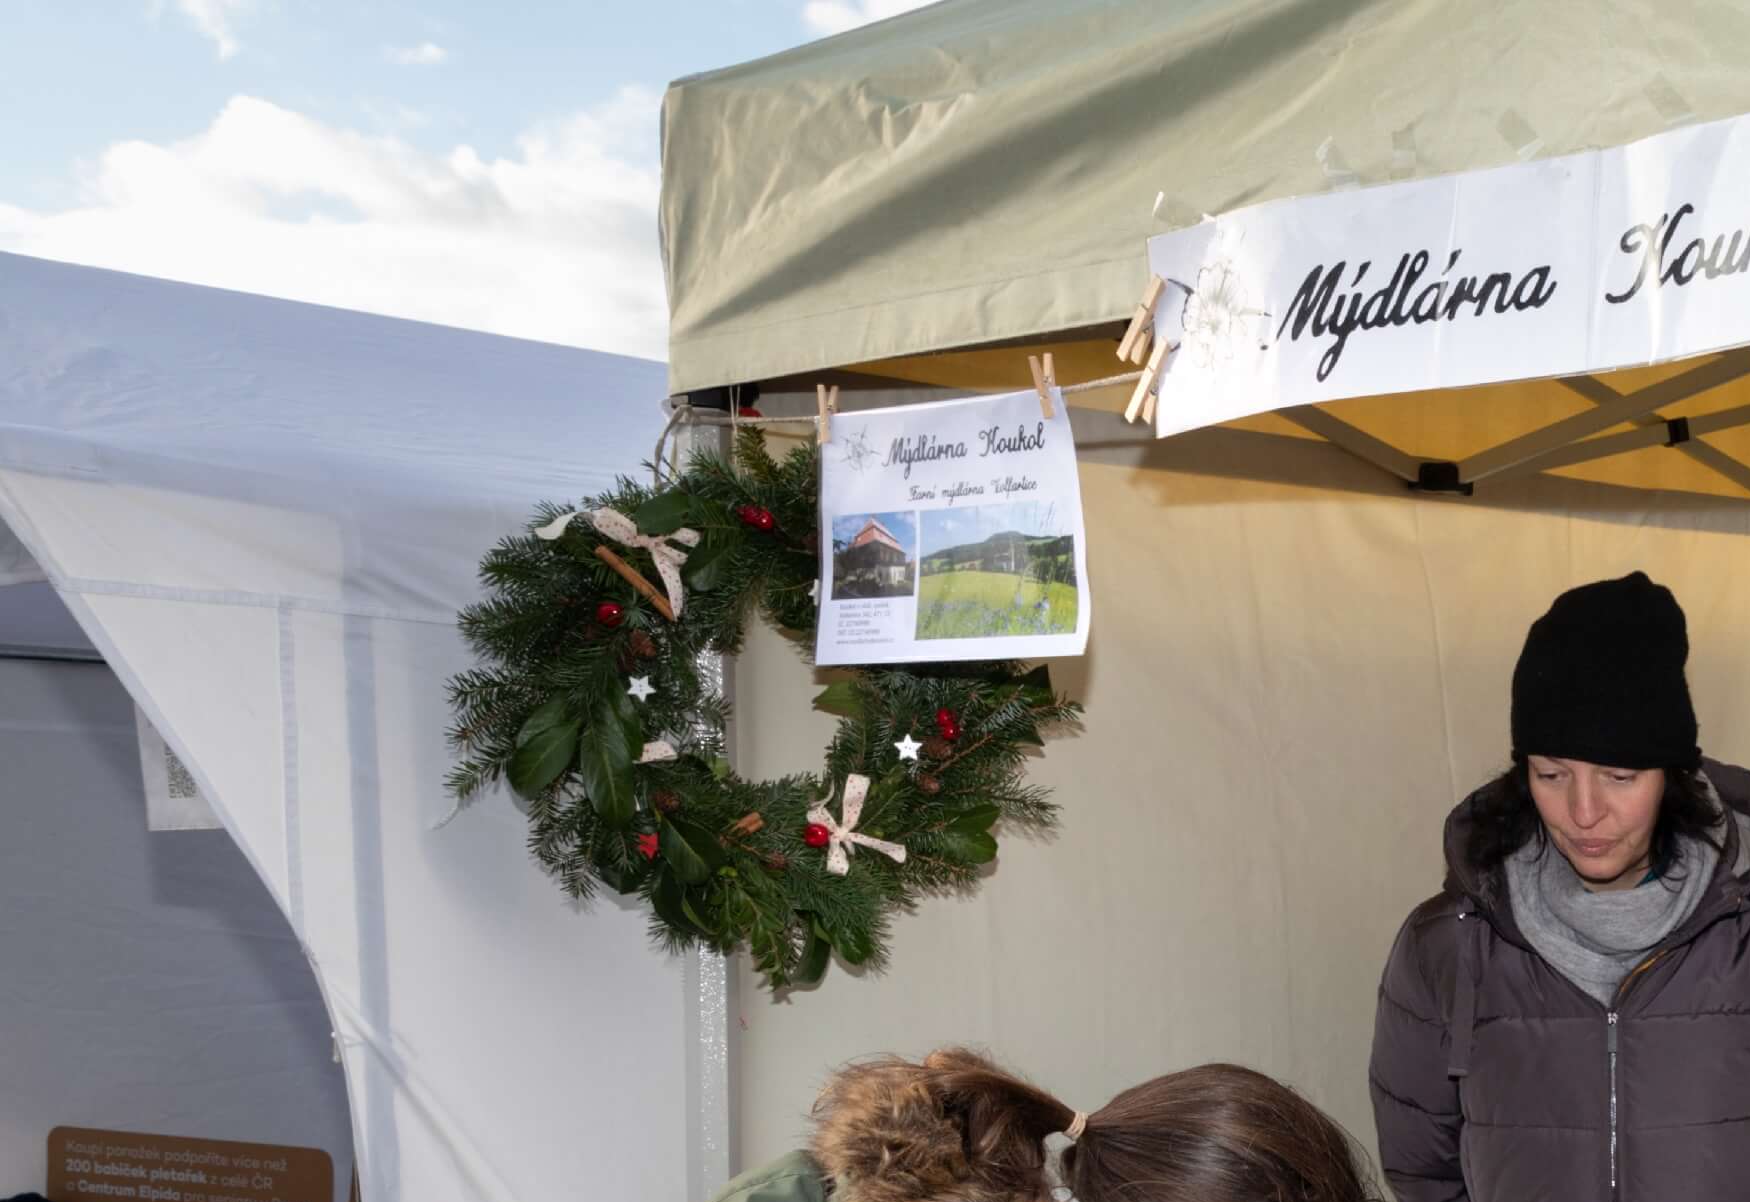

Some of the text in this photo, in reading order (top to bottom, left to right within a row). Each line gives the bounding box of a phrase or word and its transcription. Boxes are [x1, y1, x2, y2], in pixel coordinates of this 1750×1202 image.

[1277, 247, 1555, 382] Mýdlárna
[882, 421, 1045, 479] Mýdlárna Koukol
[65, 1158, 91, 1173] 200
[251, 1174, 273, 1191] ČR
[77, 1179, 136, 1198] Centrum
